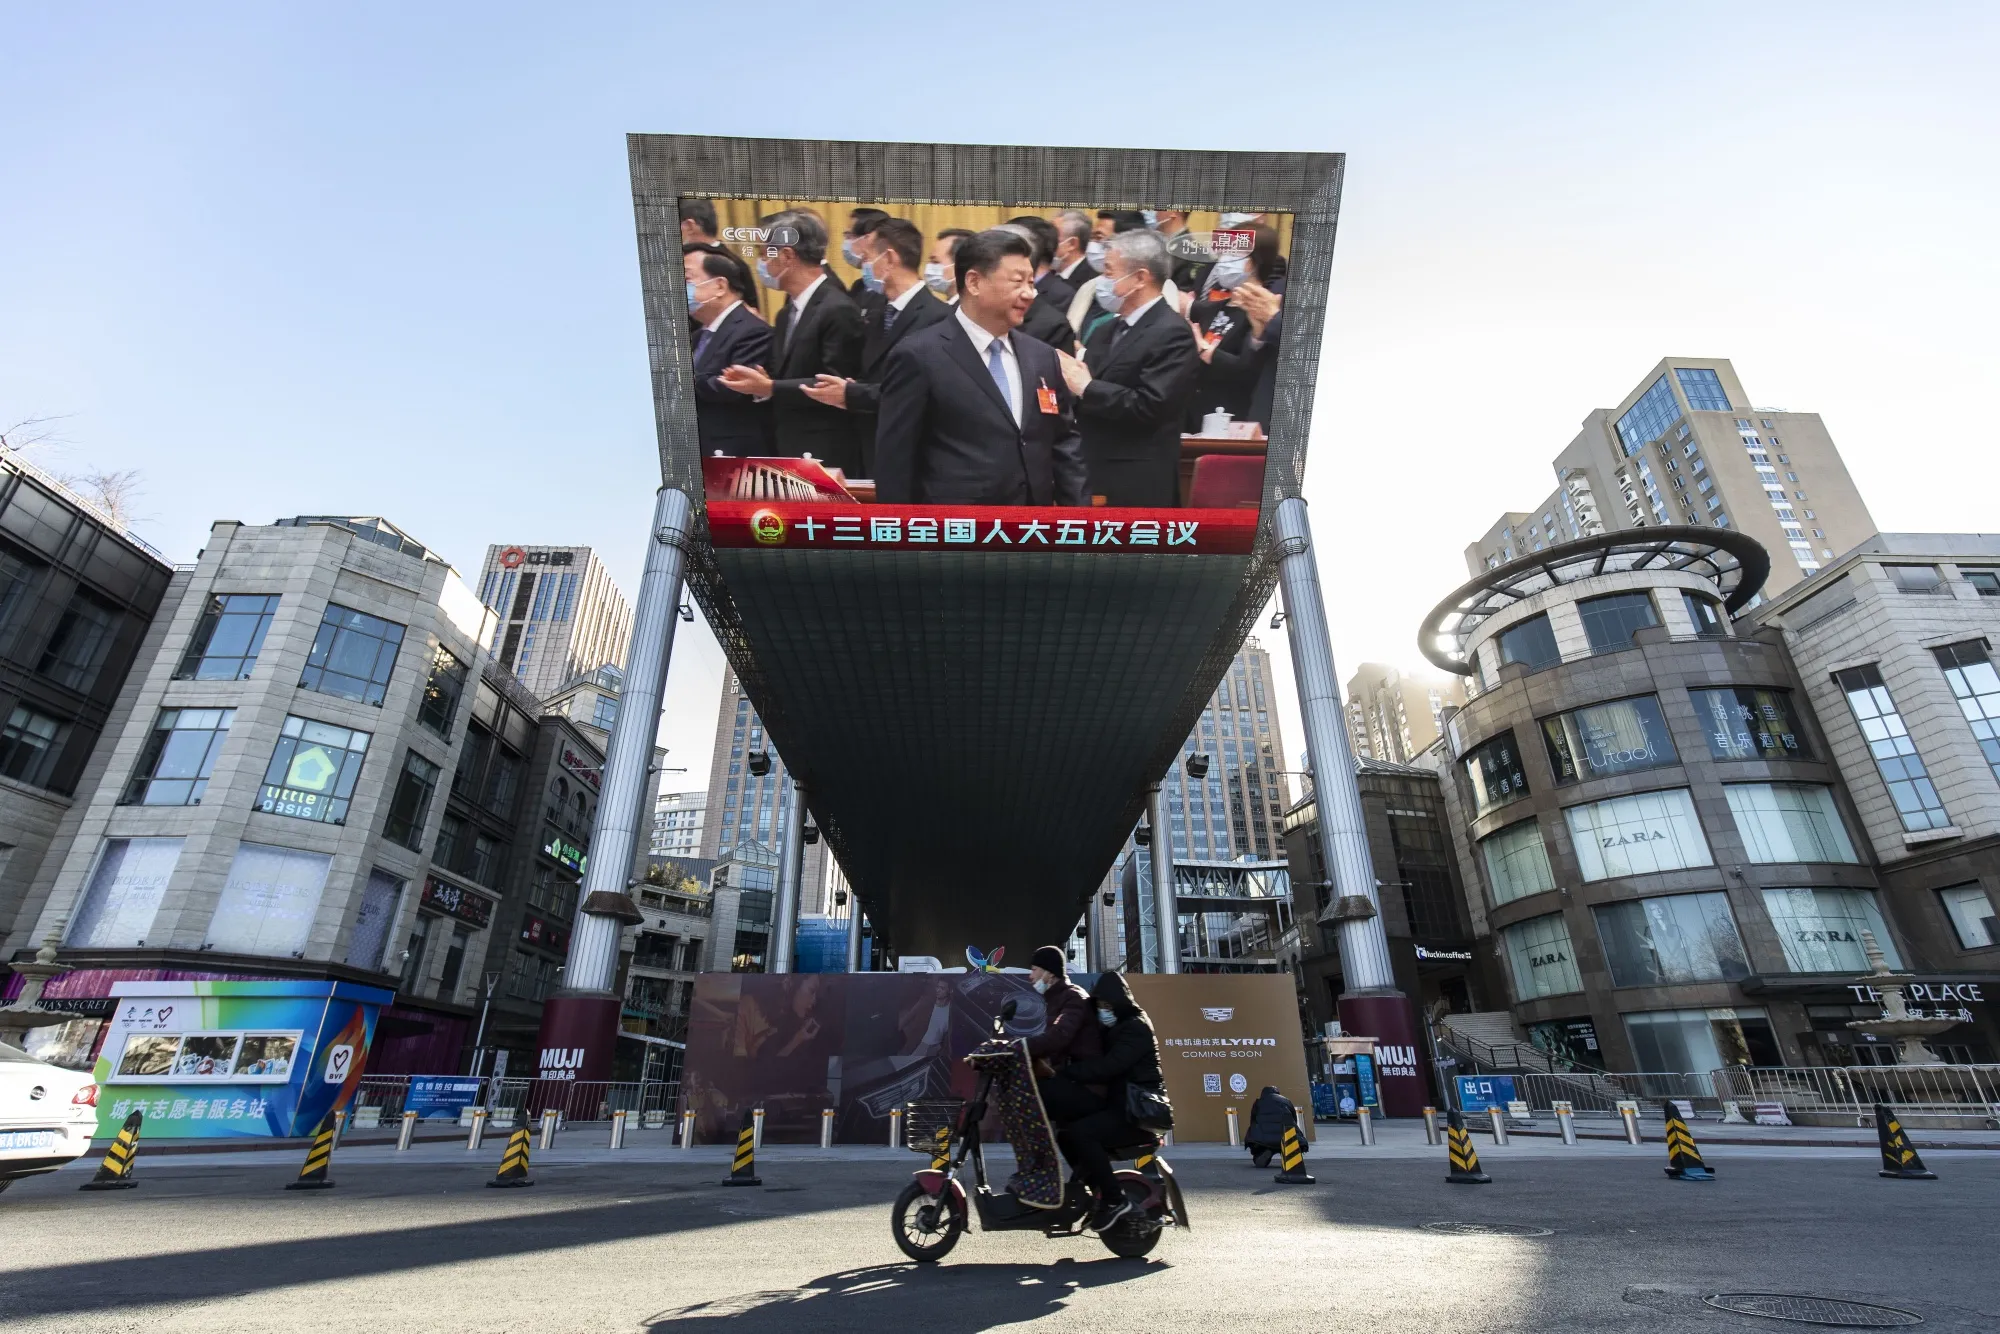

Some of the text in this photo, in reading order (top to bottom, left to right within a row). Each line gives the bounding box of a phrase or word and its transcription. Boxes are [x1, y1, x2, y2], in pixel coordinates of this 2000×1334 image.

[722, 227, 789, 243] CCTV 1
[1217, 232, 1250, 248] 直播
[741, 245, 778, 257] 综合
[794, 515, 1200, 547] 十三届全国人大五次会议
[1713, 732, 1798, 749] 音乐酒馆
[1602, 830, 1666, 848] ZARA
[1796, 930, 1857, 942] ZARA
[1531, 952, 1568, 967] ZARA
[1909, 983, 1985, 1001] PLACE
[65, 1000, 111, 1011] SECRET
[539, 1048, 585, 1069] MUJI
[1374, 1046, 1417, 1065] MUJI
[540, 1069, 576, 1080] 無印良品
[1381, 1066, 1417, 1077] 無印良品
[415, 1082, 453, 1091] 疫情防控
[1464, 1081, 1493, 1094] 出口
[109, 1098, 268, 1120] 城市志愿者服务站
